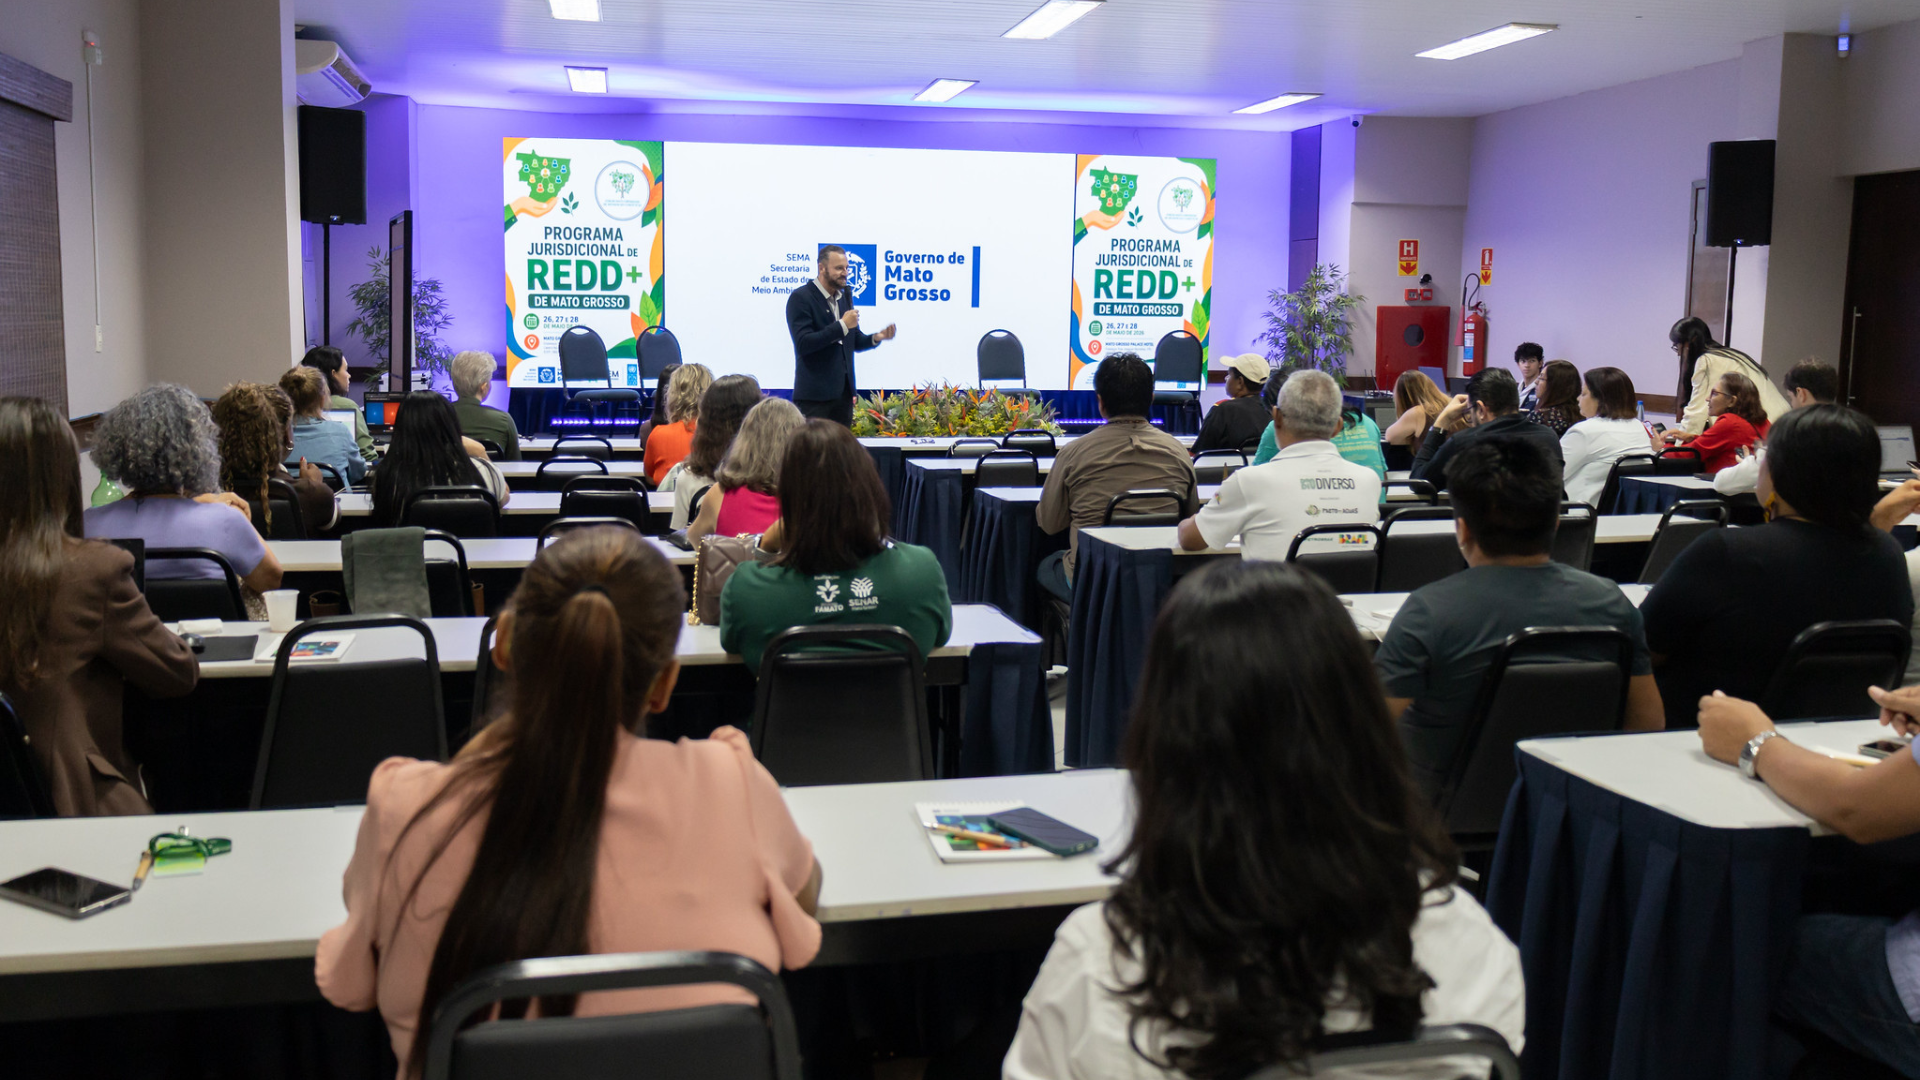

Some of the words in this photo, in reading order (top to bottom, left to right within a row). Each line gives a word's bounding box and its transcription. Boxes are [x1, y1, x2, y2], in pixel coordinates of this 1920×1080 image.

[544, 226, 624, 242] PROGRAMA
[527, 242, 625, 258] JURISDICIONAL
[627, 247, 638, 258] DE
[1111, 238, 1181, 253] PROGRAMA
[1403, 241, 1415, 256] H
[786, 253, 811, 262] SEMA
[884, 250, 945, 264] Governo
[948, 251, 965, 265] de
[1095, 253, 1181, 268] JURISDICIONAL
[1183, 258, 1193, 268] DE
[770, 263, 811, 273] Secretaria
[885, 265, 933, 283] Mato
[760, 275, 770, 283] de
[772, 275, 798, 283] Estado
[752, 286, 771, 294] Meio
[773, 286, 794, 294] Ambi
[884, 284, 951, 302] Grosso
[534, 296, 548, 307] DE
[550, 296, 580, 308] MATO
[582, 296, 625, 308] GROSSO
[1099, 304, 1111, 315] DE
[1113, 304, 1140, 315] MATO
[1142, 304, 1179, 316] GROSSO
[543, 315, 554, 324] 26,
[1106, 322, 1116, 330] 26,
[848, 596, 879, 606] SENAR
